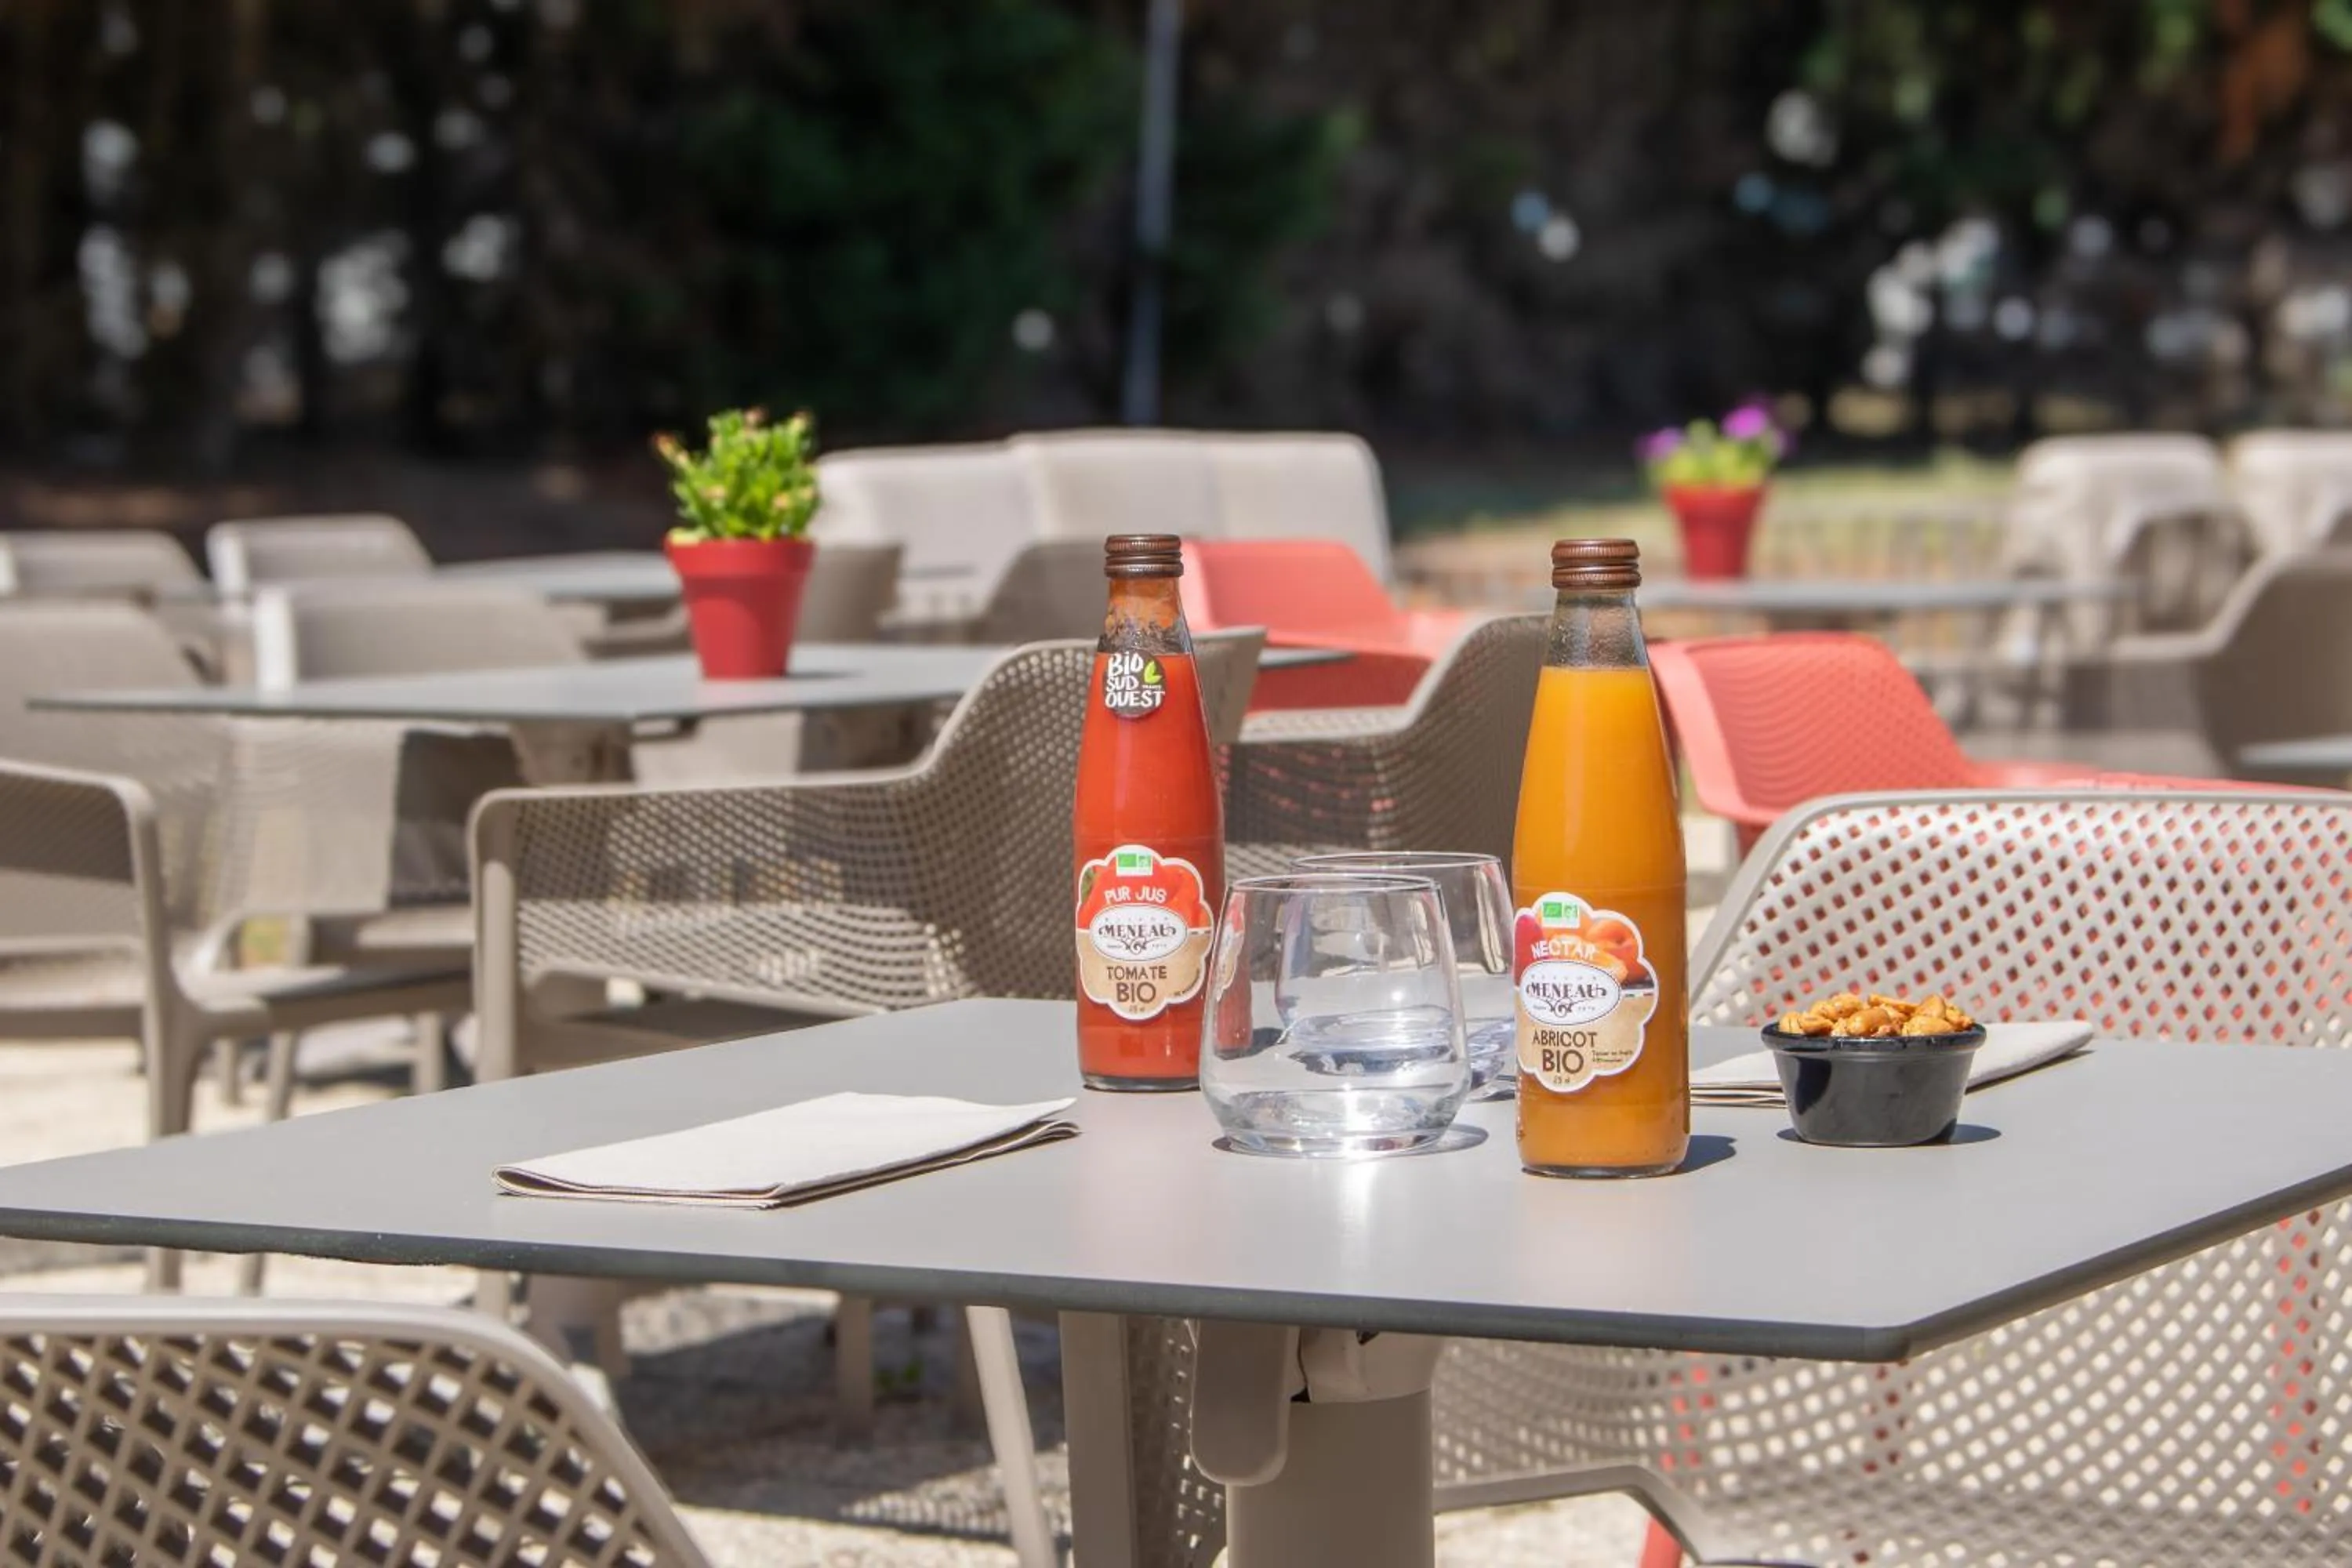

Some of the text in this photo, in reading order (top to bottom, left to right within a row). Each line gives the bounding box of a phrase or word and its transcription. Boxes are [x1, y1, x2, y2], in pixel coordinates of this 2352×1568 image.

[1106, 675, 1139, 691] SUD
[1105, 690, 1166, 709] OUEST
[1104, 886, 1167, 904] PUR JUS
[1531, 938, 1597, 960] NECTAR
[1107, 965, 1167, 980] TOMATE
[1116, 982, 1156, 1004] BIO
[1532, 1029, 1597, 1048] ABRICOT
[1542, 1048, 1584, 1074] BIO
